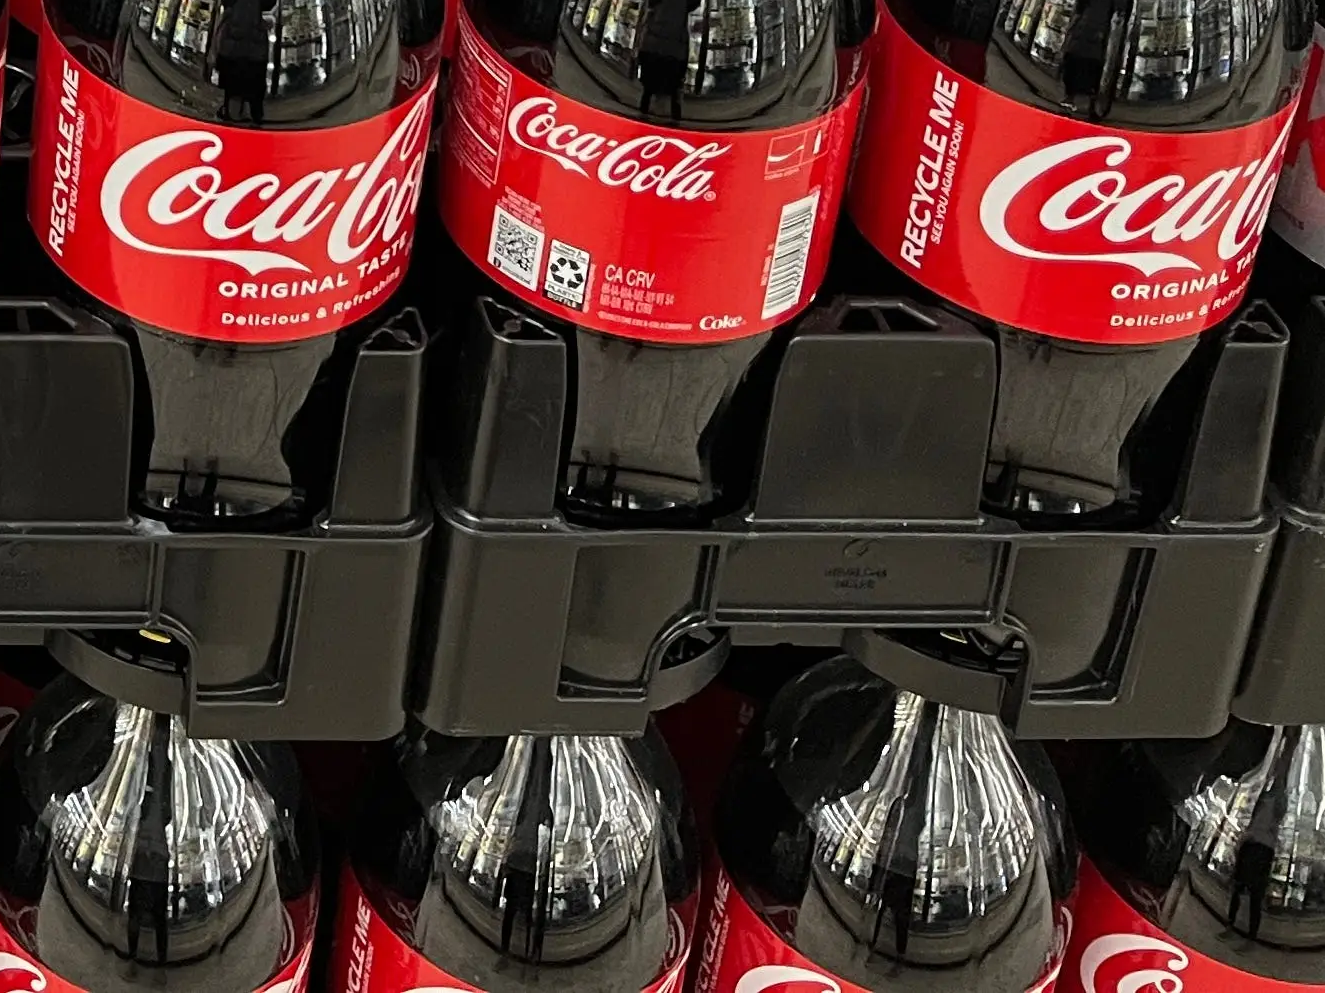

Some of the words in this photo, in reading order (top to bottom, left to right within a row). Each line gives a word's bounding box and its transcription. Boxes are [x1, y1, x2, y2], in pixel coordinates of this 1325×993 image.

[60, 59, 79, 117] ME
[508, 97, 732, 201] Coca-Cola
[48, 112, 74, 257] RECYCLE
[900, 125, 948, 269] RECYCLE
[929, 71, 959, 128] ME
[941, 158, 956, 195] AGAIN
[936, 195, 949, 221] YOU
[930, 220, 943, 245] SEE
[218, 271, 348, 299] ORIGINAL
[357, 231, 407, 279] TASTE
[605, 264, 623, 284] CA
[626, 268, 657, 289] CRV
[1110, 269, 1229, 300] ORIGINAL
[221, 310, 310, 326] Delicious
[316, 306, 327, 318] &
[699, 314, 743, 332] Coke
[1110, 309, 1194, 327] Delicious
[1198, 304, 1209, 316] &
[355, 895, 371, 945] ME
